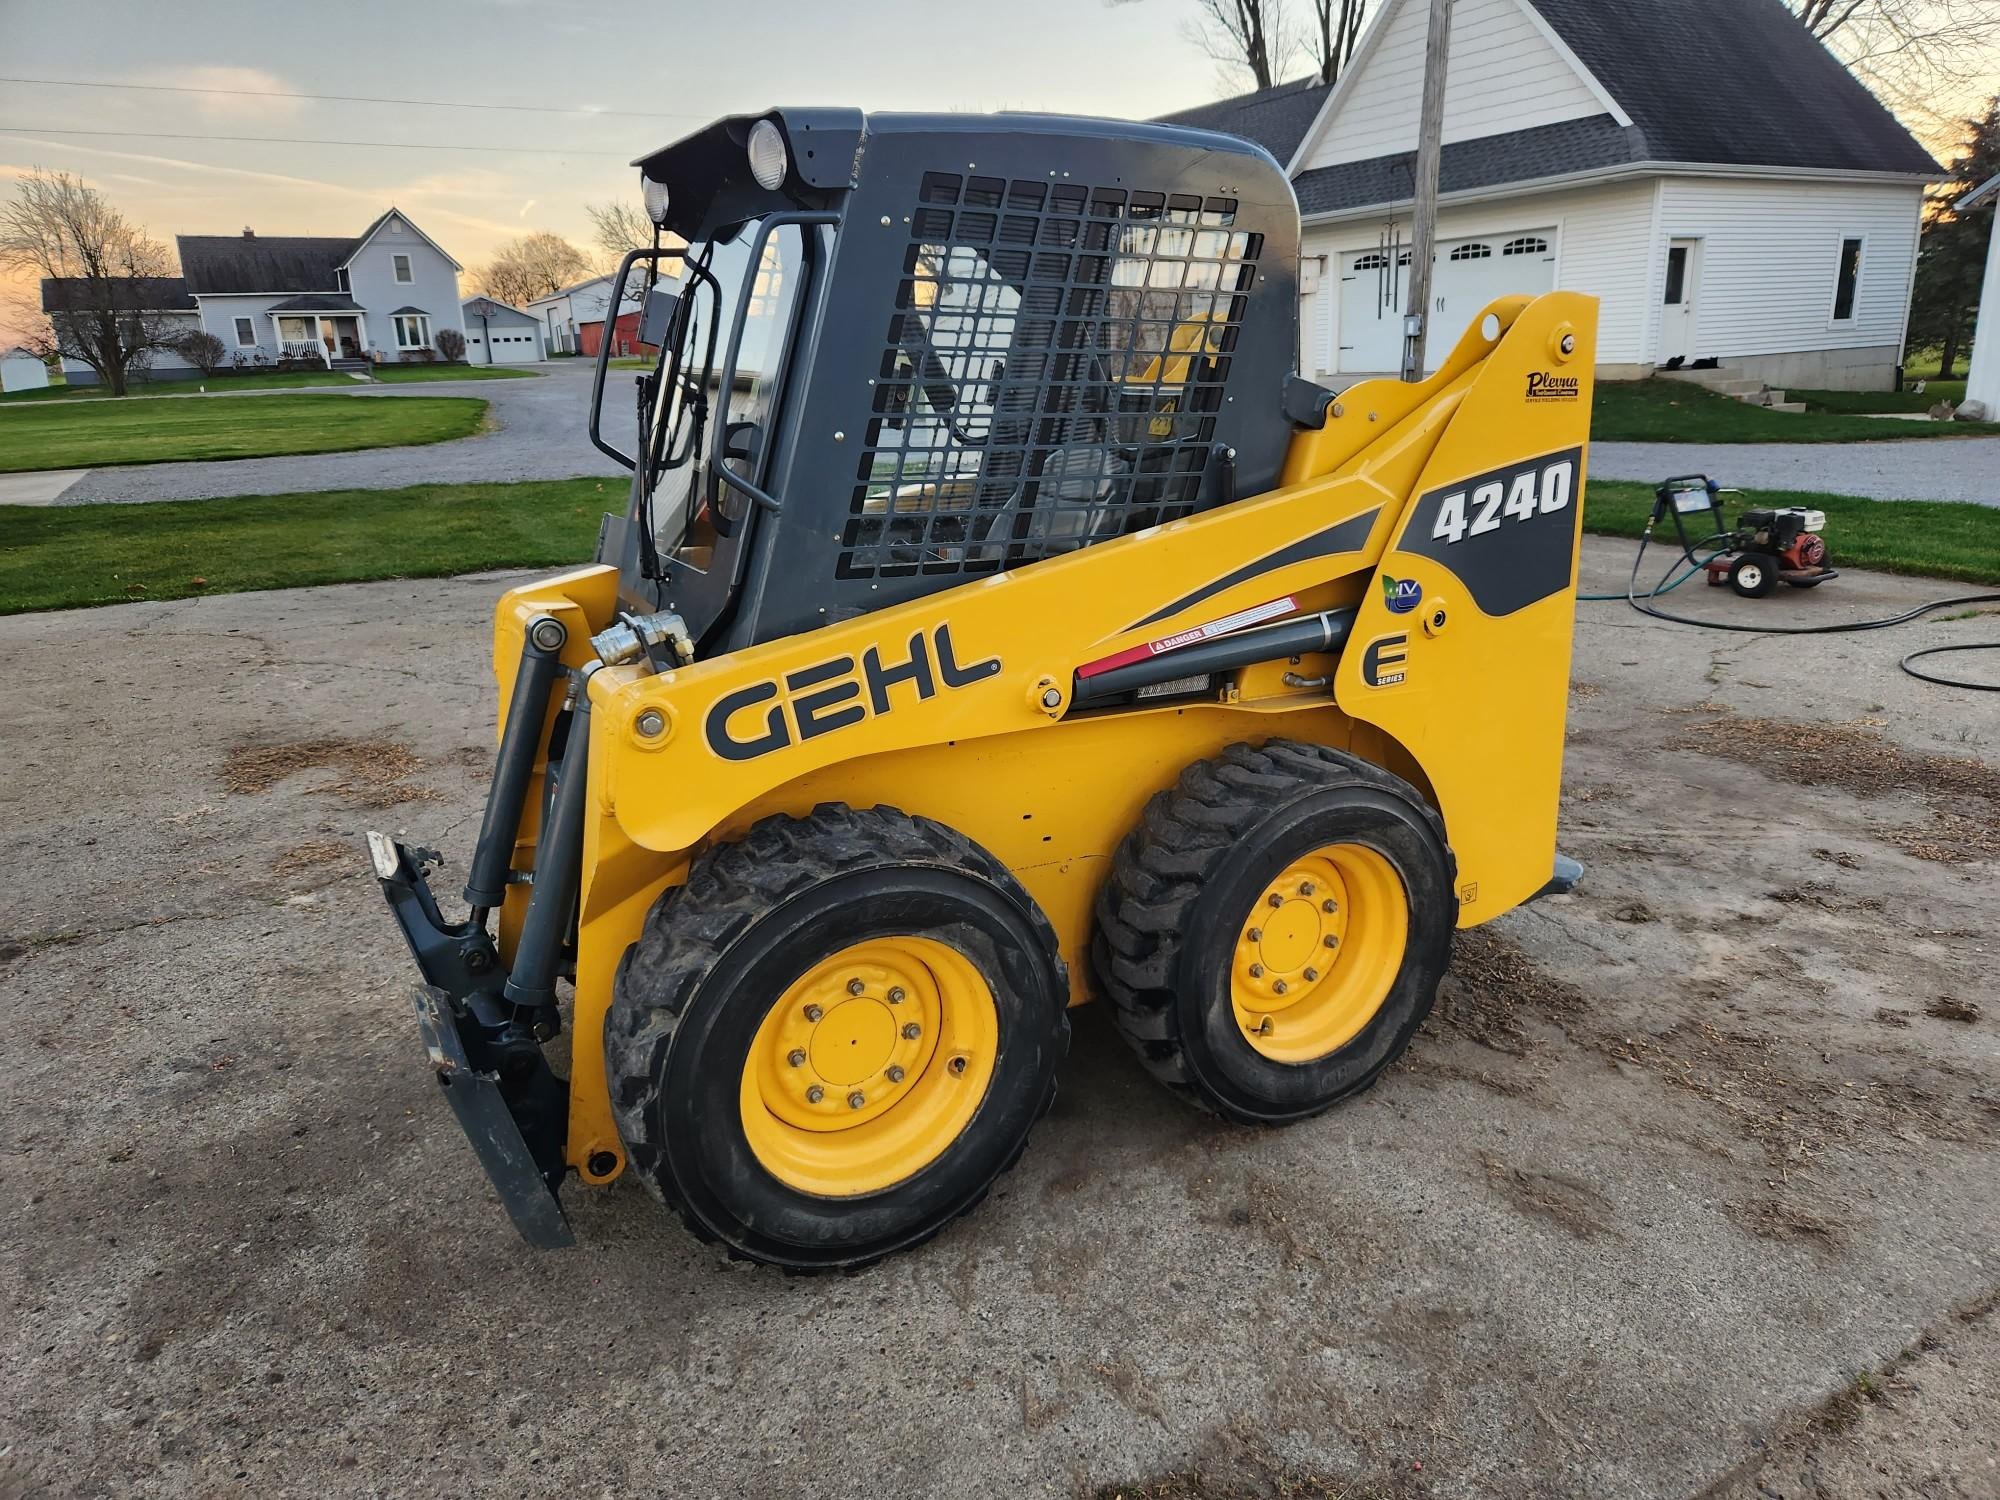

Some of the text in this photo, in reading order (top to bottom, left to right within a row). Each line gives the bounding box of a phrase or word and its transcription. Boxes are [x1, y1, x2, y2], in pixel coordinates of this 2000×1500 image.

[1526, 371, 1577, 395] Plevna
[1431, 460, 1573, 544] 4240
[1164, 630, 1203, 648] DANGER
[1377, 673, 1403, 685] SERIES
